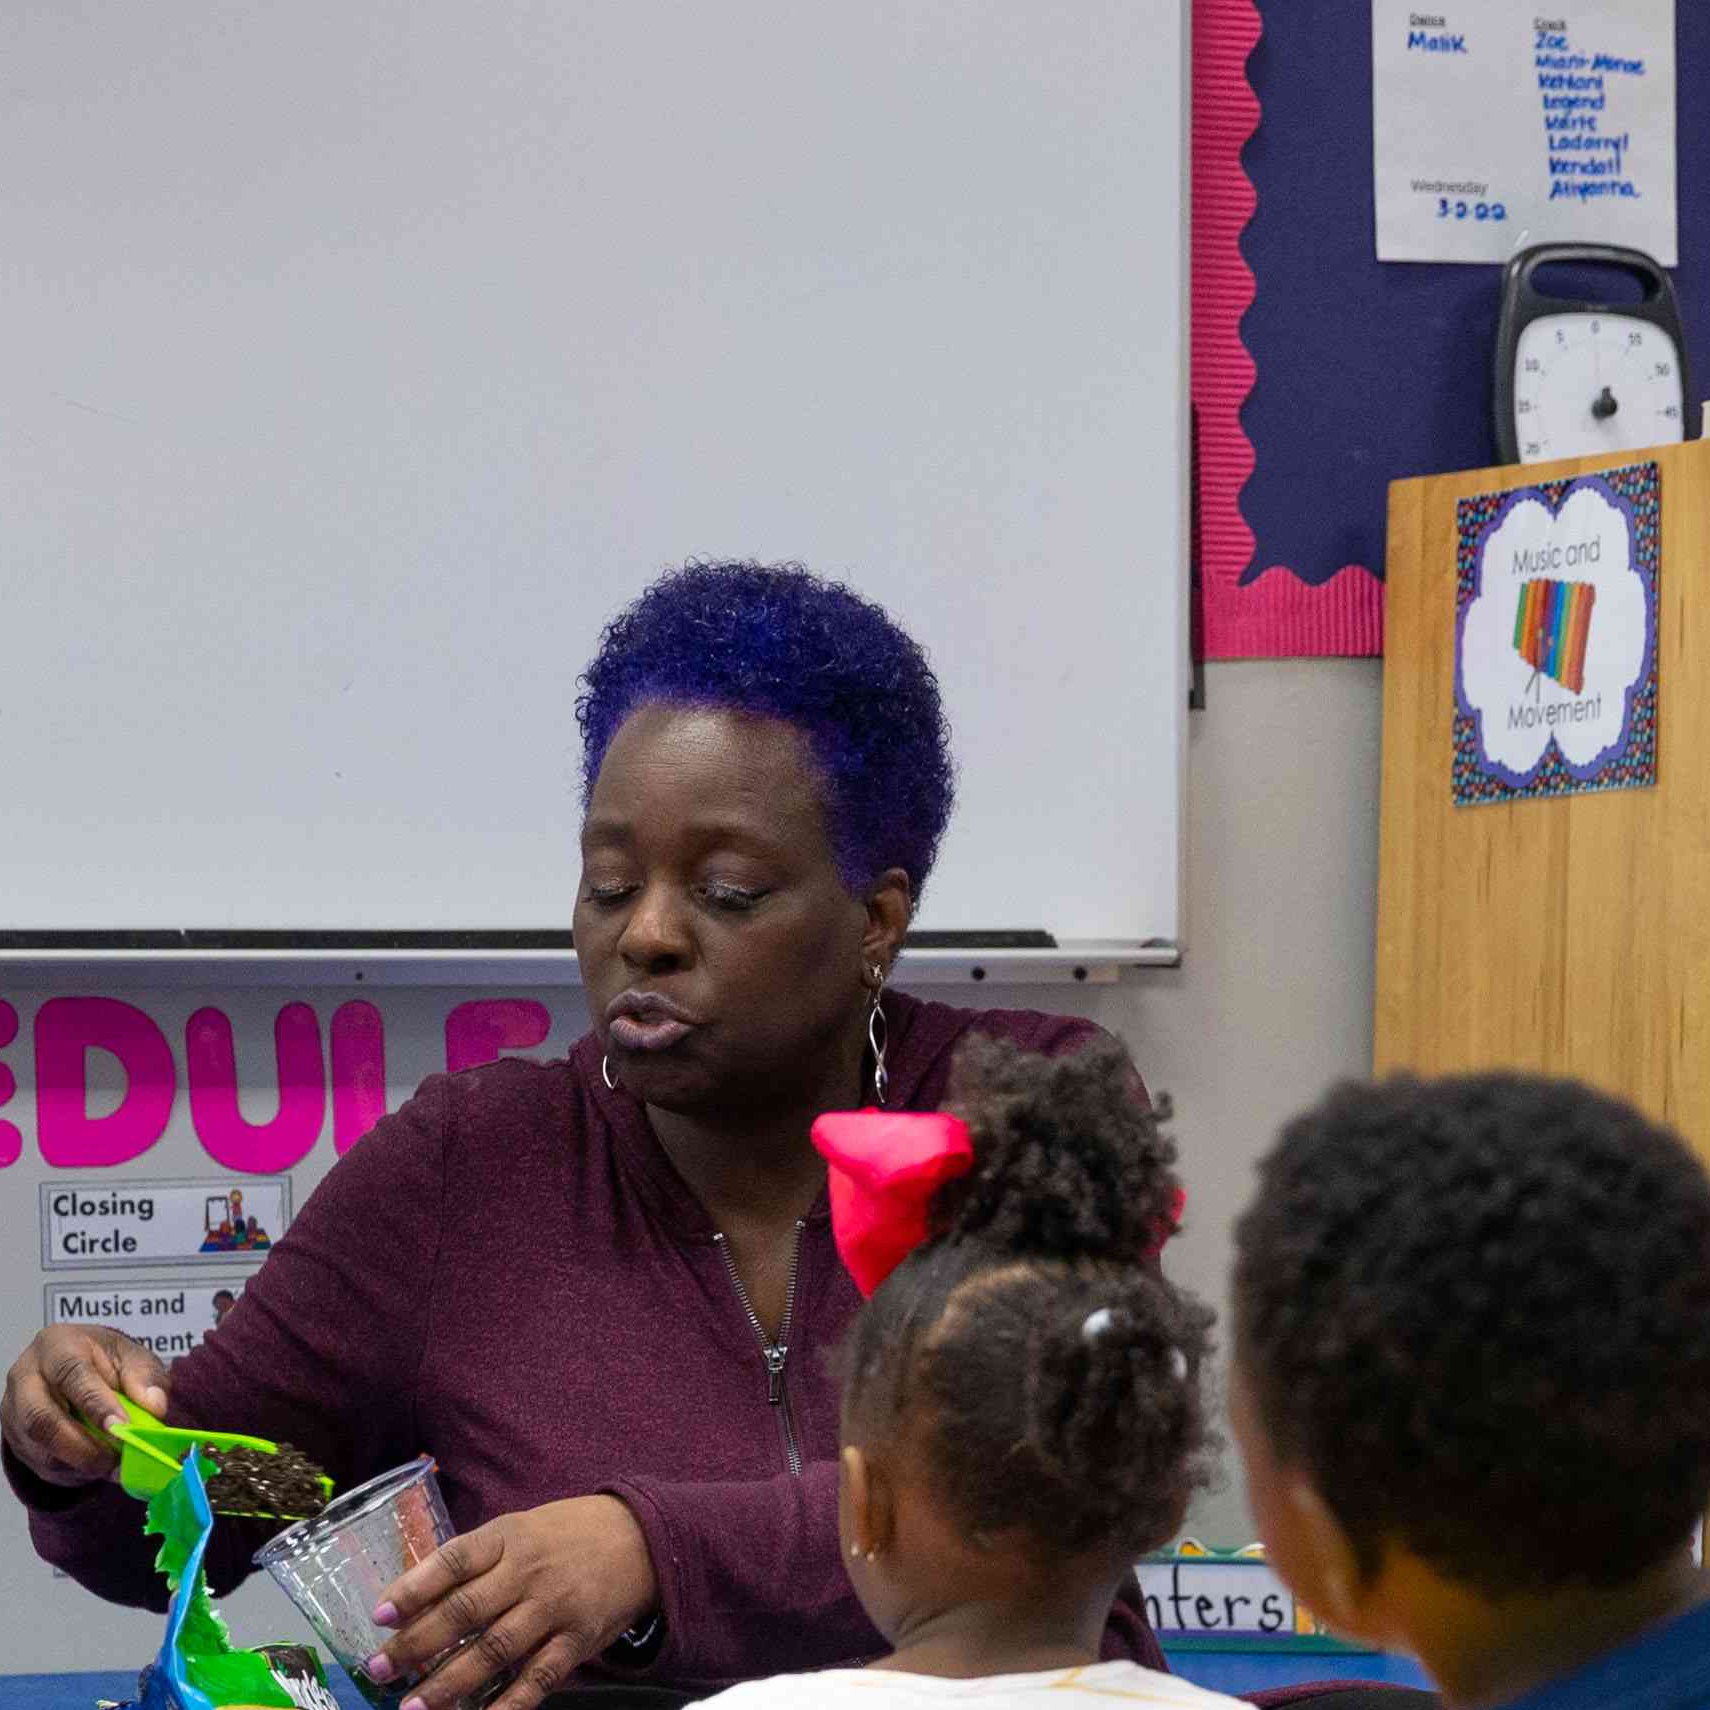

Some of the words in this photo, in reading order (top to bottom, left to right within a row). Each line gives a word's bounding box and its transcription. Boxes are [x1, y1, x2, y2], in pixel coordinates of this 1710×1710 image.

[1512, 545, 1561, 575] Music
[1565, 535, 1602, 565] and
[1507, 695, 1602, 732] Movement
[53, 1192, 154, 1220] Closing
[63, 1228, 137, 1254] Circle
[59, 1294, 132, 1317] Music
[140, 1292, 185, 1315] and
[1144, 1563, 1286, 1632] nters
